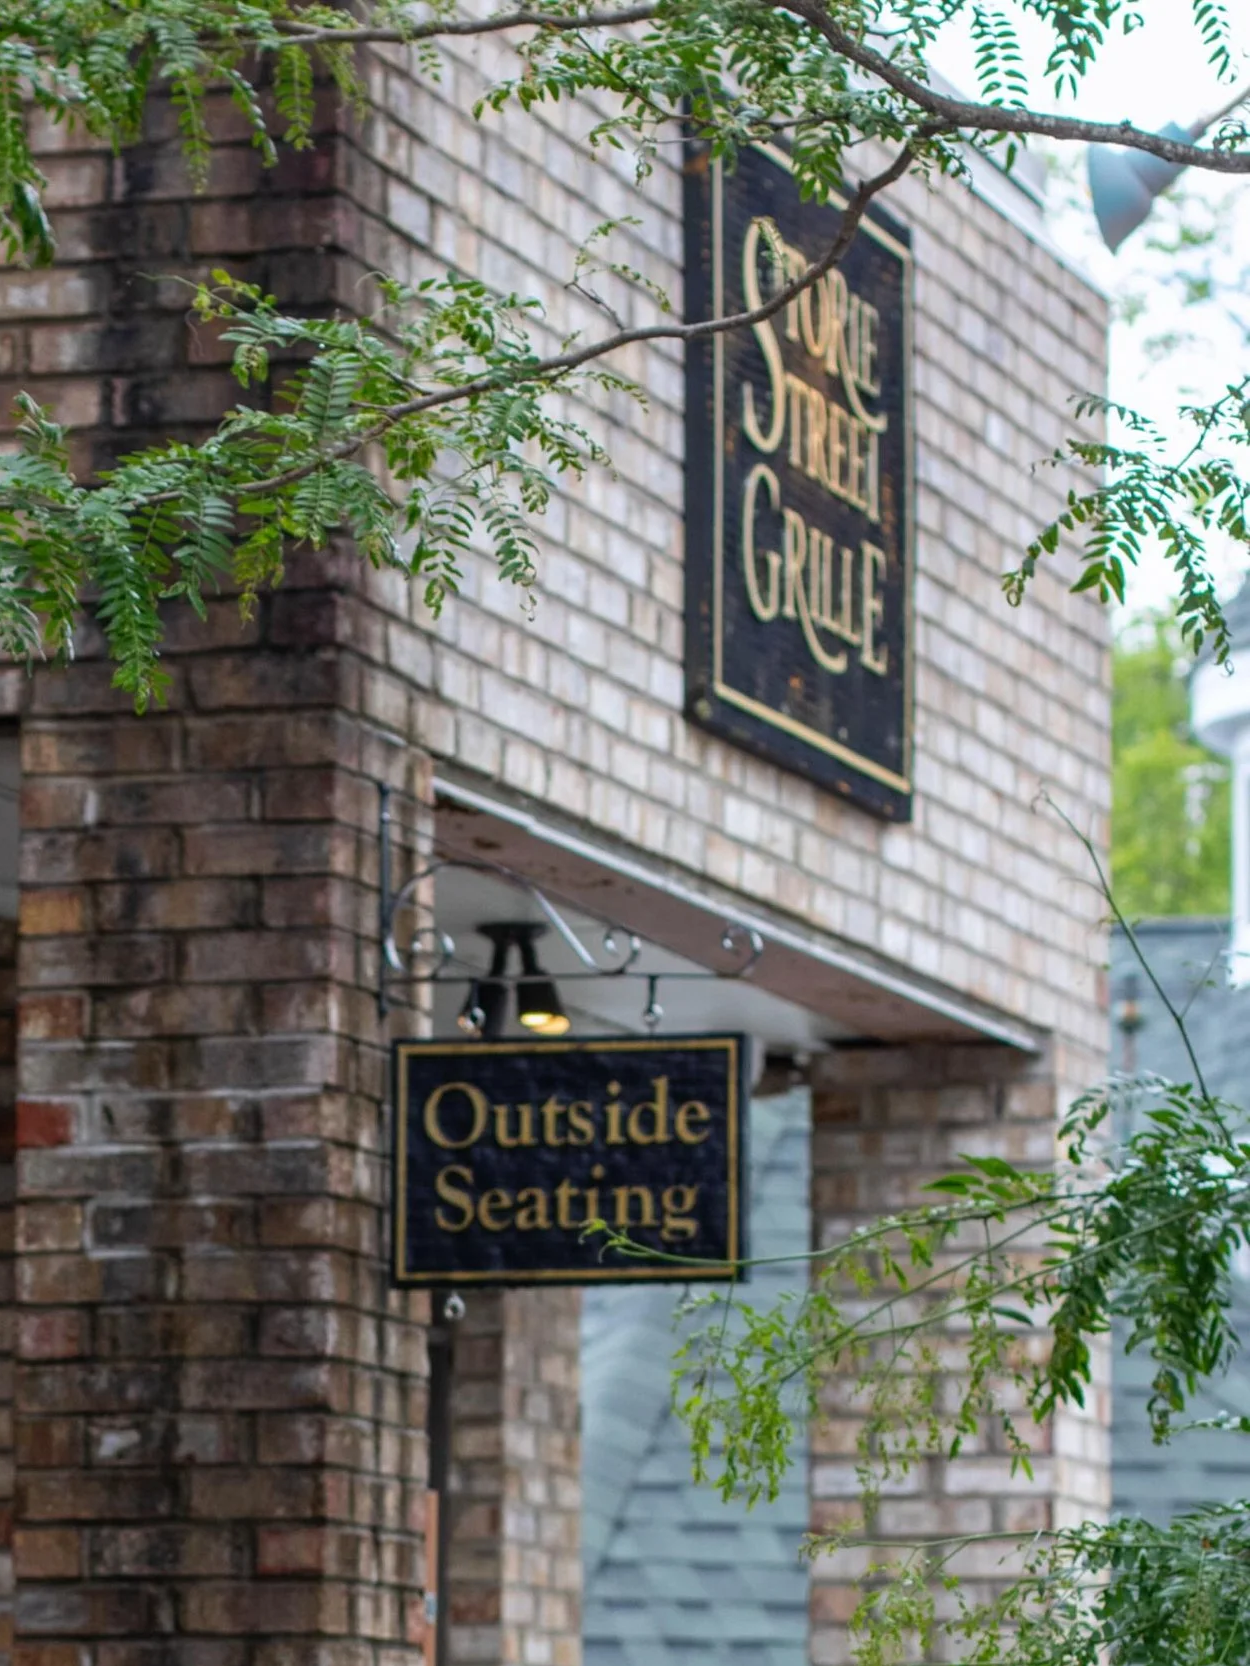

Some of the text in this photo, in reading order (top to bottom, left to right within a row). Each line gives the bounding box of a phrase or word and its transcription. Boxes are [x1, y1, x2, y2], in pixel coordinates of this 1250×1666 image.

[743, 462, 888, 677] GRILLE
[423, 1075, 711, 1150] Outside
[434, 1164, 700, 1243] Seating
